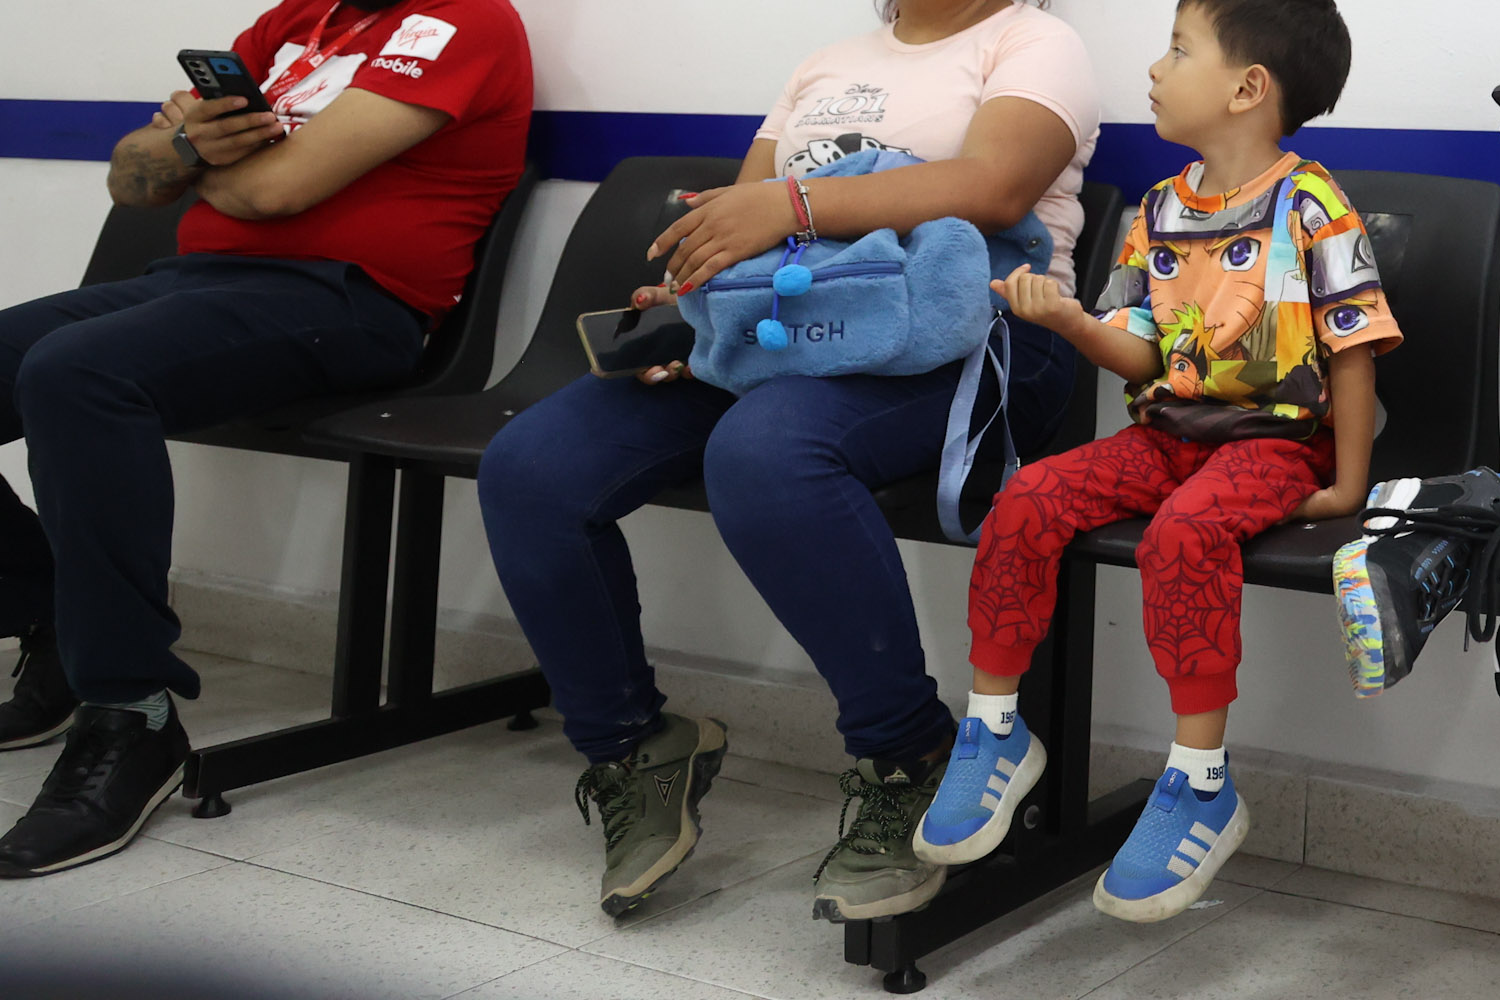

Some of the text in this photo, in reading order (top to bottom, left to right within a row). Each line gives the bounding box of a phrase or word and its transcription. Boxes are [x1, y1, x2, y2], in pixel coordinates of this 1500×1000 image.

[398, 20, 439, 49] Virgin
[371, 58, 423, 78] mobile
[803, 93, 889, 118] 101
[743, 321, 844, 345] STGH
[1206, 765, 1225, 780] 198
